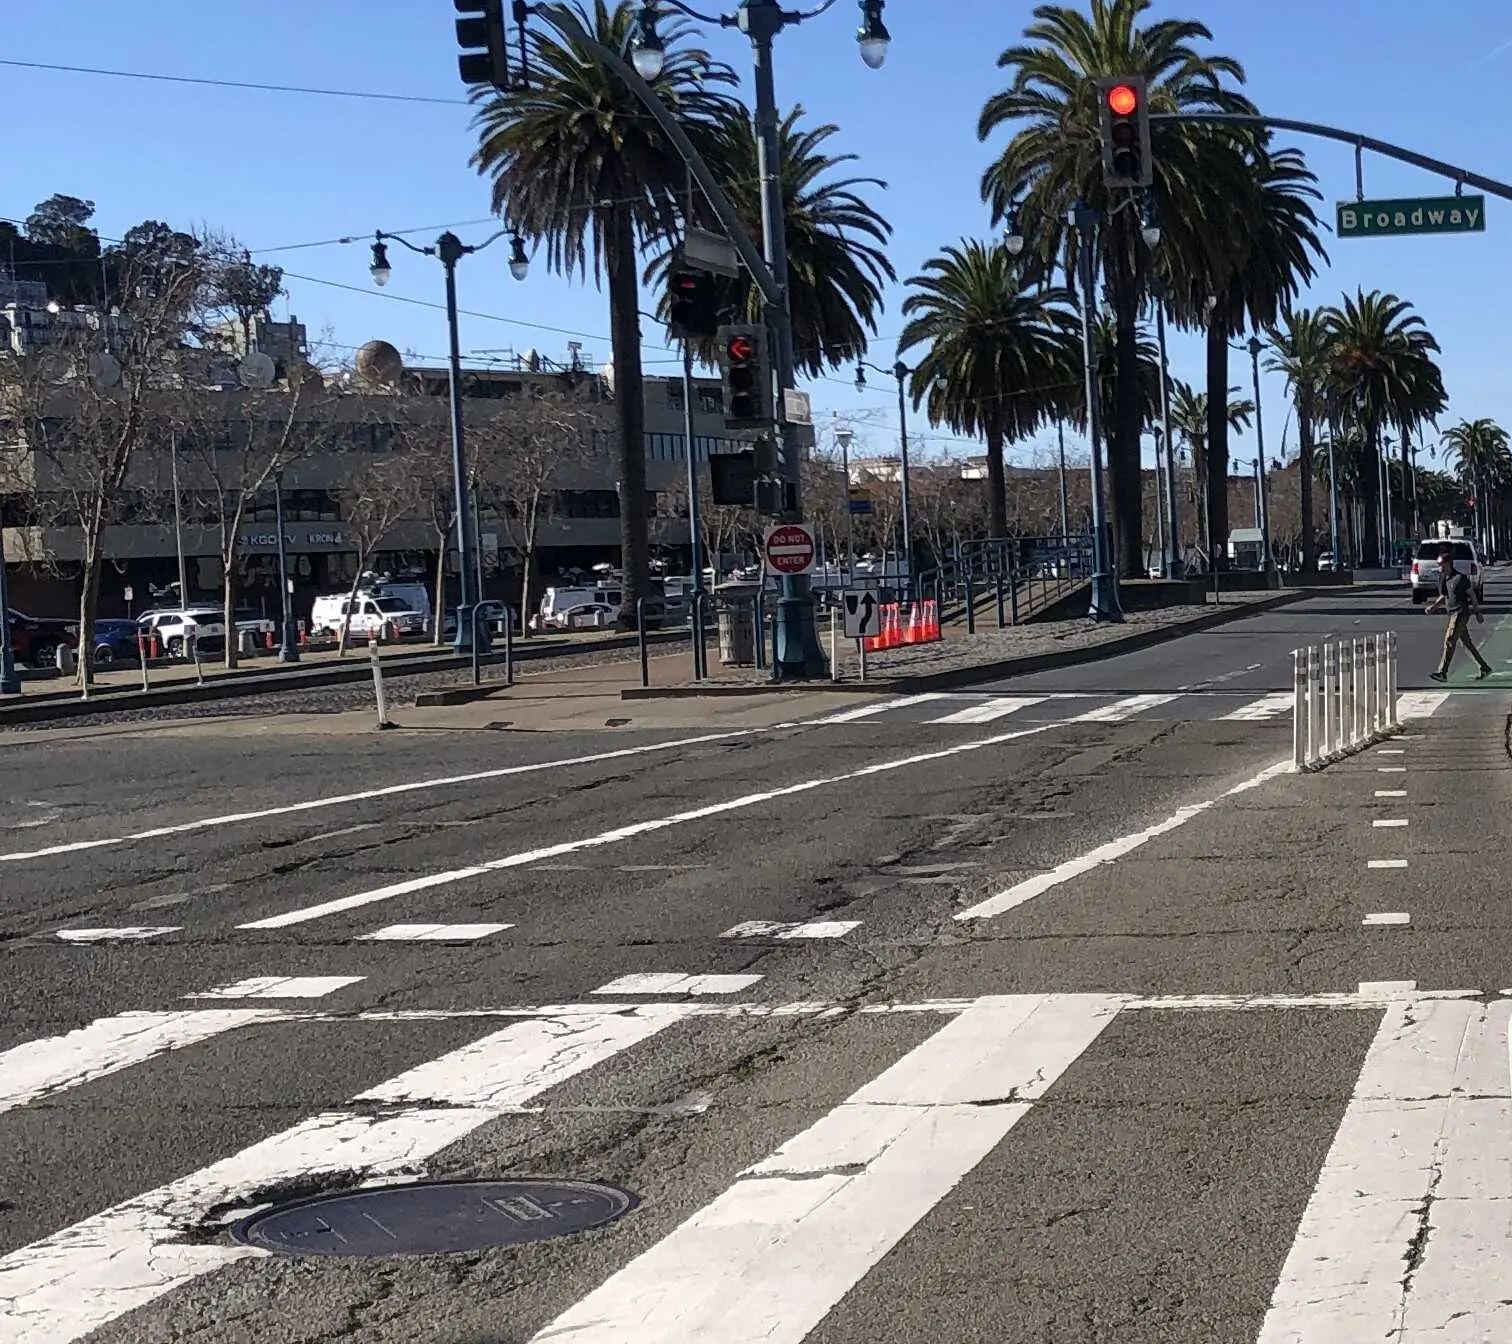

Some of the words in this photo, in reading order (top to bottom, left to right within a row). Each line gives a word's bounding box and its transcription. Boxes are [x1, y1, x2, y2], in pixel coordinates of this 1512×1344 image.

[1341, 207, 1479, 229] Broadway
[250, 535, 297, 545] KGOTV
[773, 535, 786, 544] DO
[788, 534, 805, 544] NOT
[777, 556, 805, 566] ENTER
